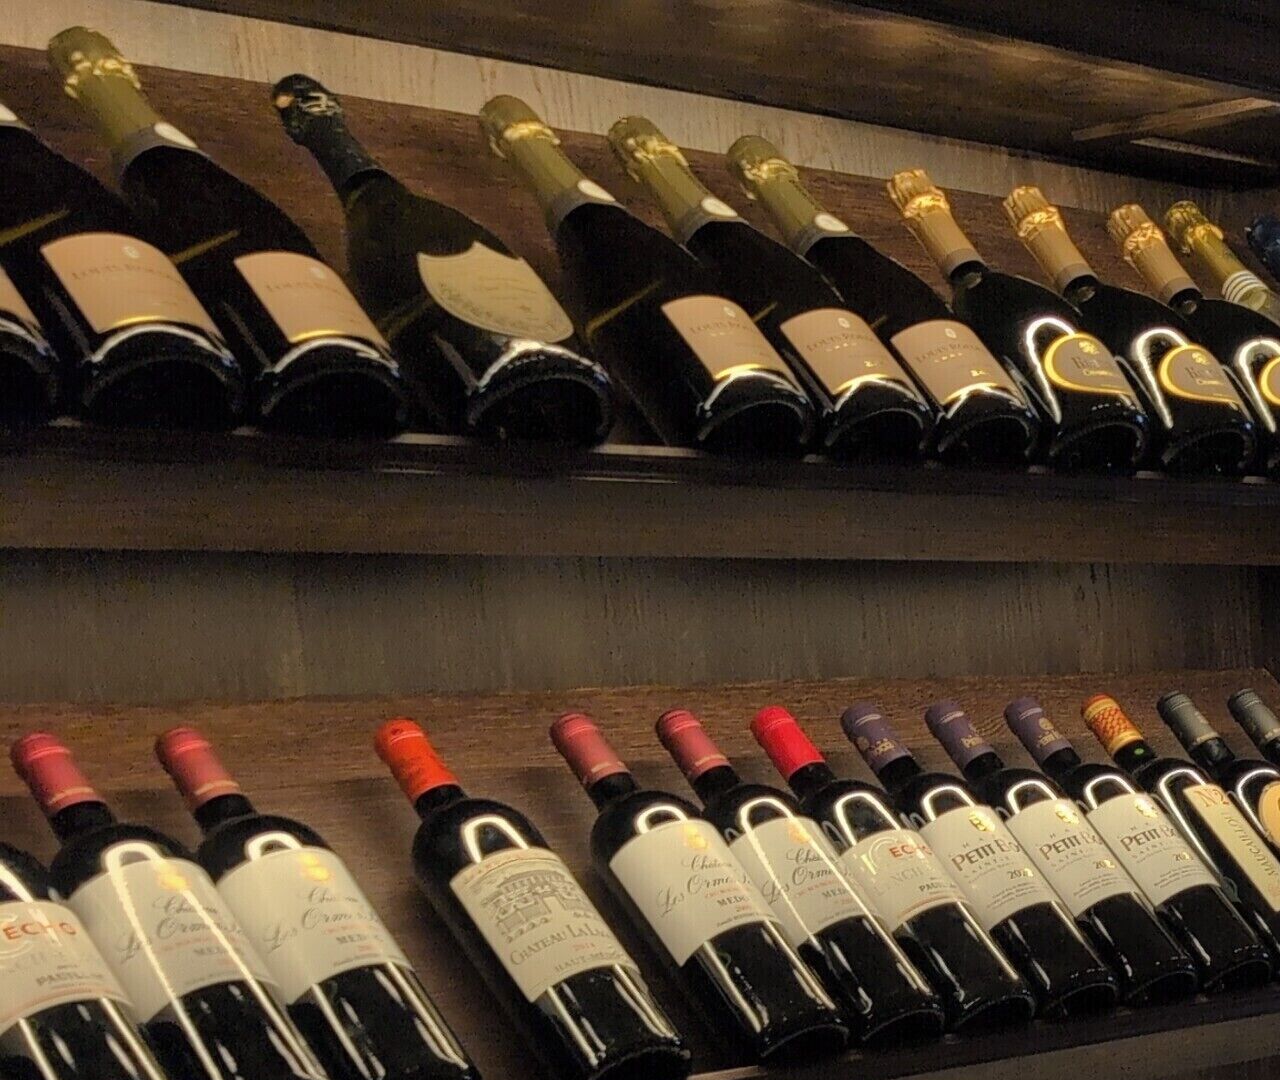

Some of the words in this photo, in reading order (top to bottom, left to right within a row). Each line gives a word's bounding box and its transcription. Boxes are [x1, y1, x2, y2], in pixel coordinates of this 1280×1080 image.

[1039, 833, 1082, 860] PETIT
[1120, 828, 1161, 852] PETIT
[951, 843, 995, 872] PETIT
[2, 922, 77, 940] ECO
